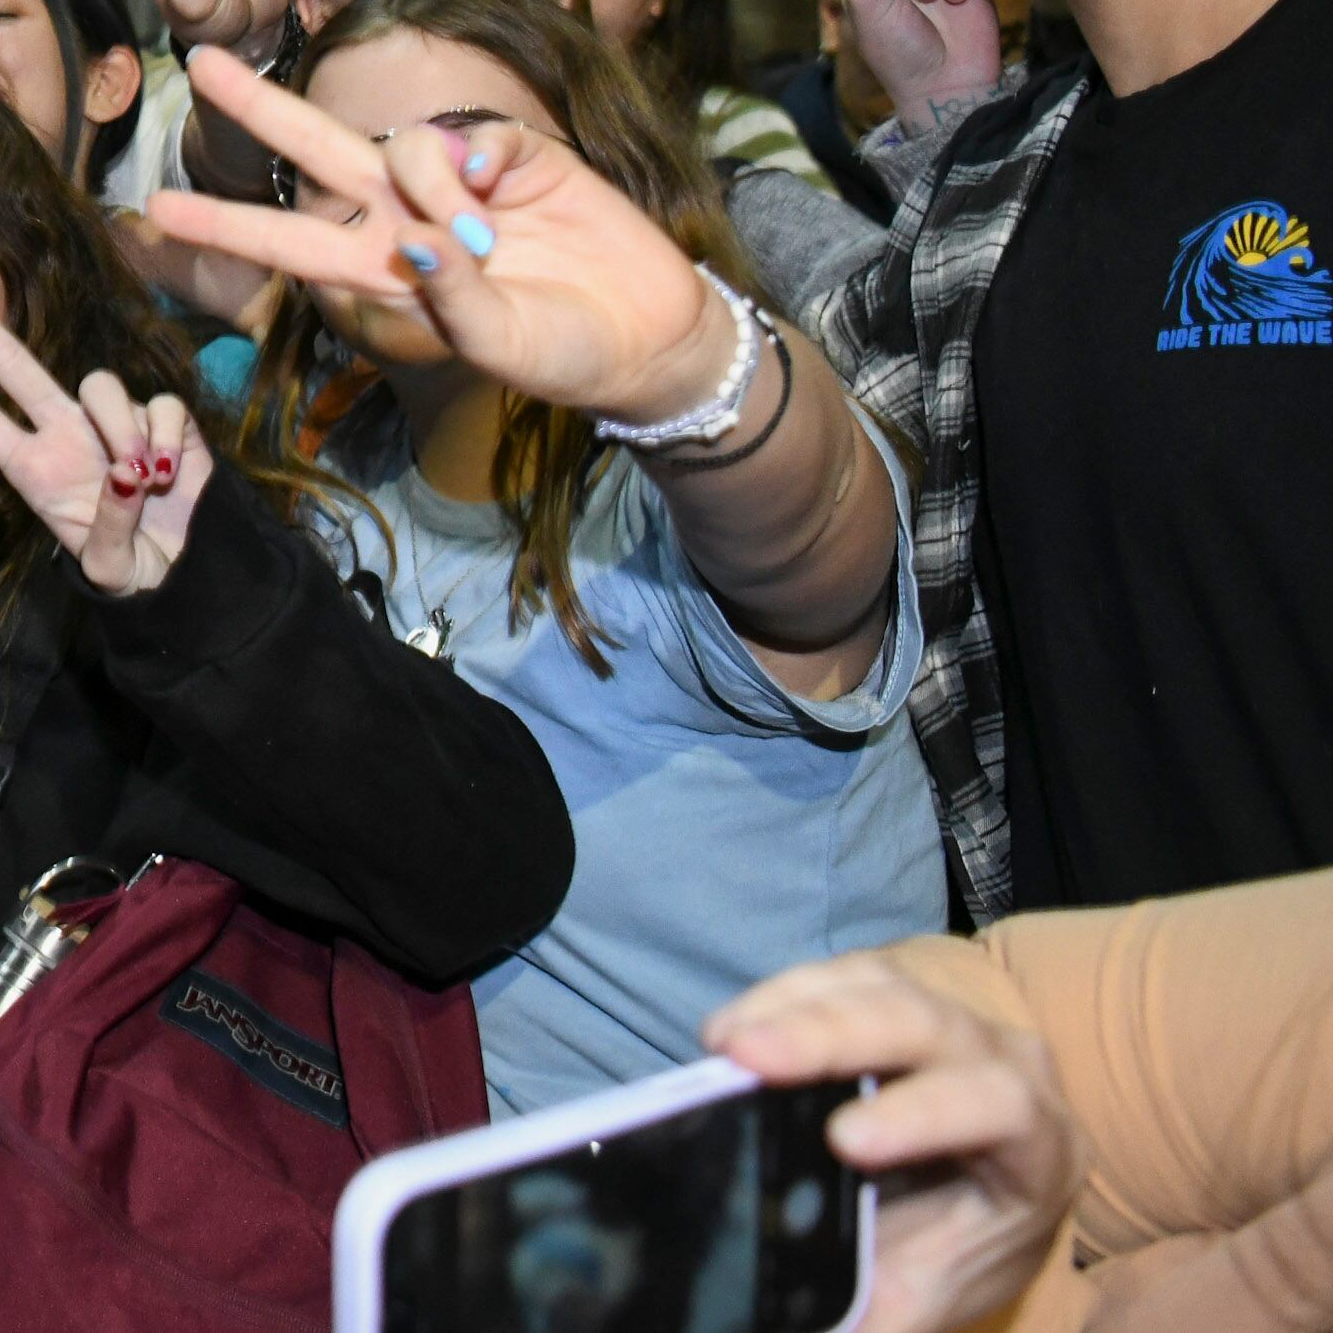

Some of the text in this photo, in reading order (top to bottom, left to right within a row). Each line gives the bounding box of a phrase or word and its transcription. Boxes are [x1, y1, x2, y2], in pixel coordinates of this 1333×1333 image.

[1156, 320, 1333, 352] RIDE THE WAVE
